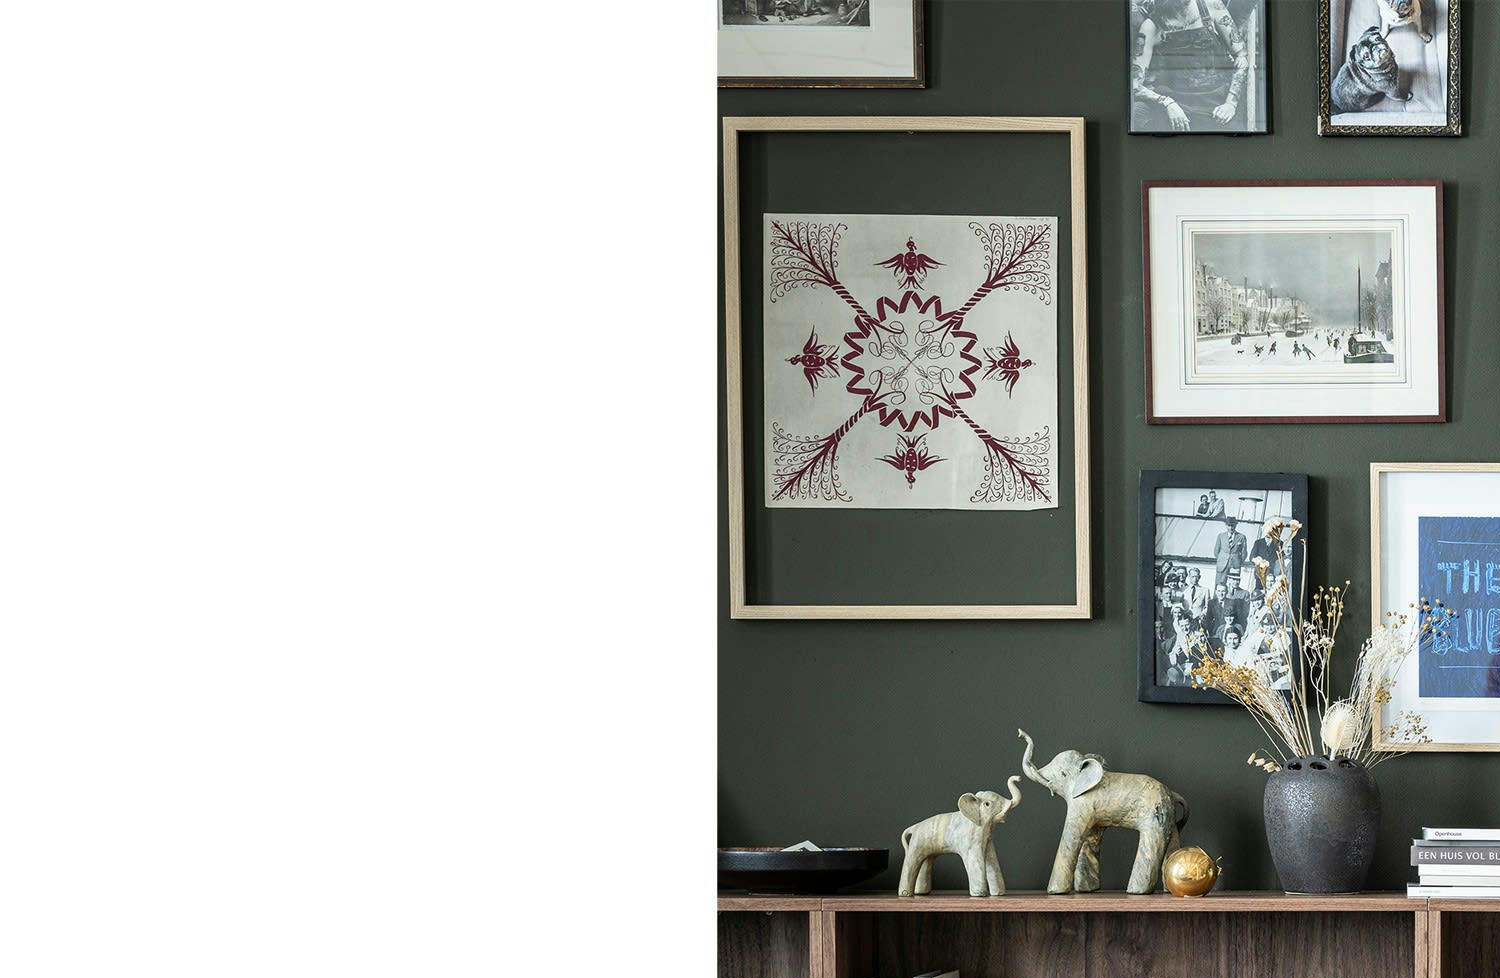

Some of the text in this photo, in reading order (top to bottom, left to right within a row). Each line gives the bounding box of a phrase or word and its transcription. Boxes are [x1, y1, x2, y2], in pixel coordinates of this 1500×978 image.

[1418, 851, 1437, 859] EEN
[1440, 851, 1463, 860] HUIS
[1466, 852, 1486, 860] VOL
